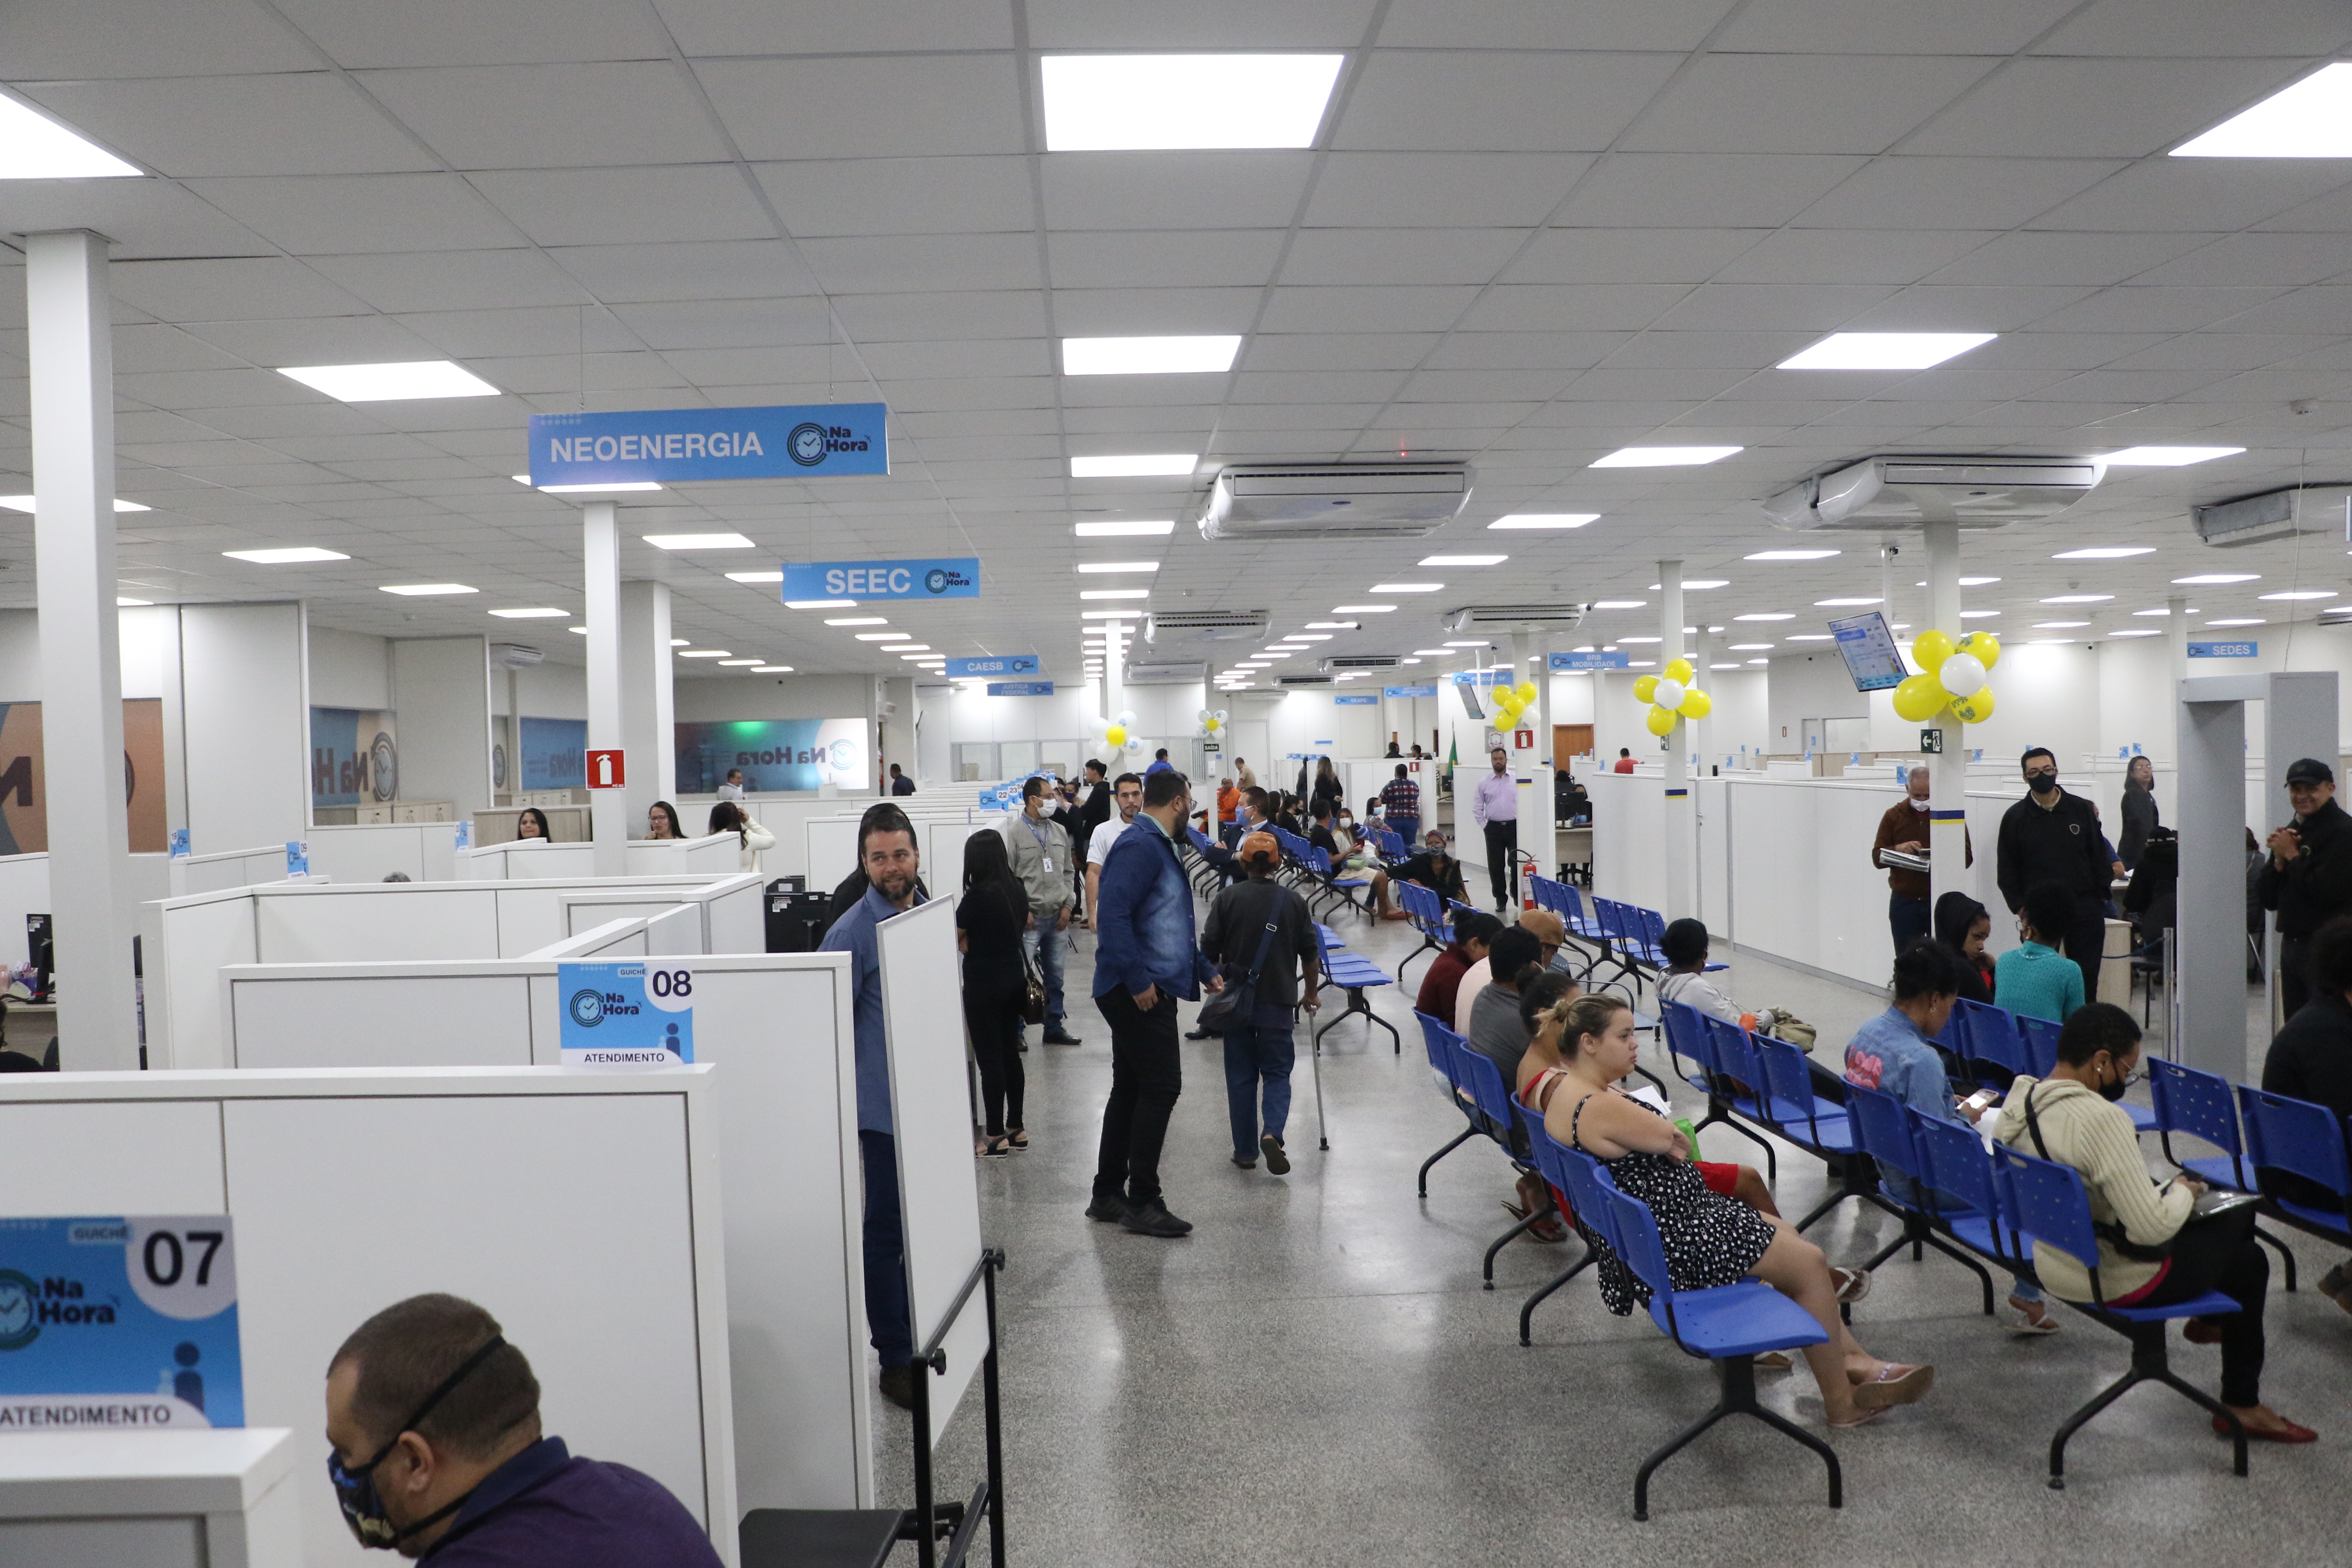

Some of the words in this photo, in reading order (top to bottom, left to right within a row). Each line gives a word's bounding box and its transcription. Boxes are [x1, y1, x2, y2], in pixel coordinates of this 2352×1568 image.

[830, 426, 851, 438] Na
[551, 432, 764, 462] NEOENERGIA
[826, 438, 868, 452] Hora
[825, 568, 911, 594] SEEC
[2212, 645, 2251, 655] SEDES
[967, 662, 1004, 671] CAESB
[301, 843, 307, 853] 09
[652, 970, 692, 997] 08
[606, 993, 625, 1003] Na
[603, 1004, 639, 1015] Hora
[585, 1054, 665, 1063] ATENDIMENTO
[143, 1230, 223, 1287] 07
[44, 1277, 83, 1298] Na
[38, 1301, 116, 1324] Hora
[0, 1404, 171, 1425] ATENDIMENTO
